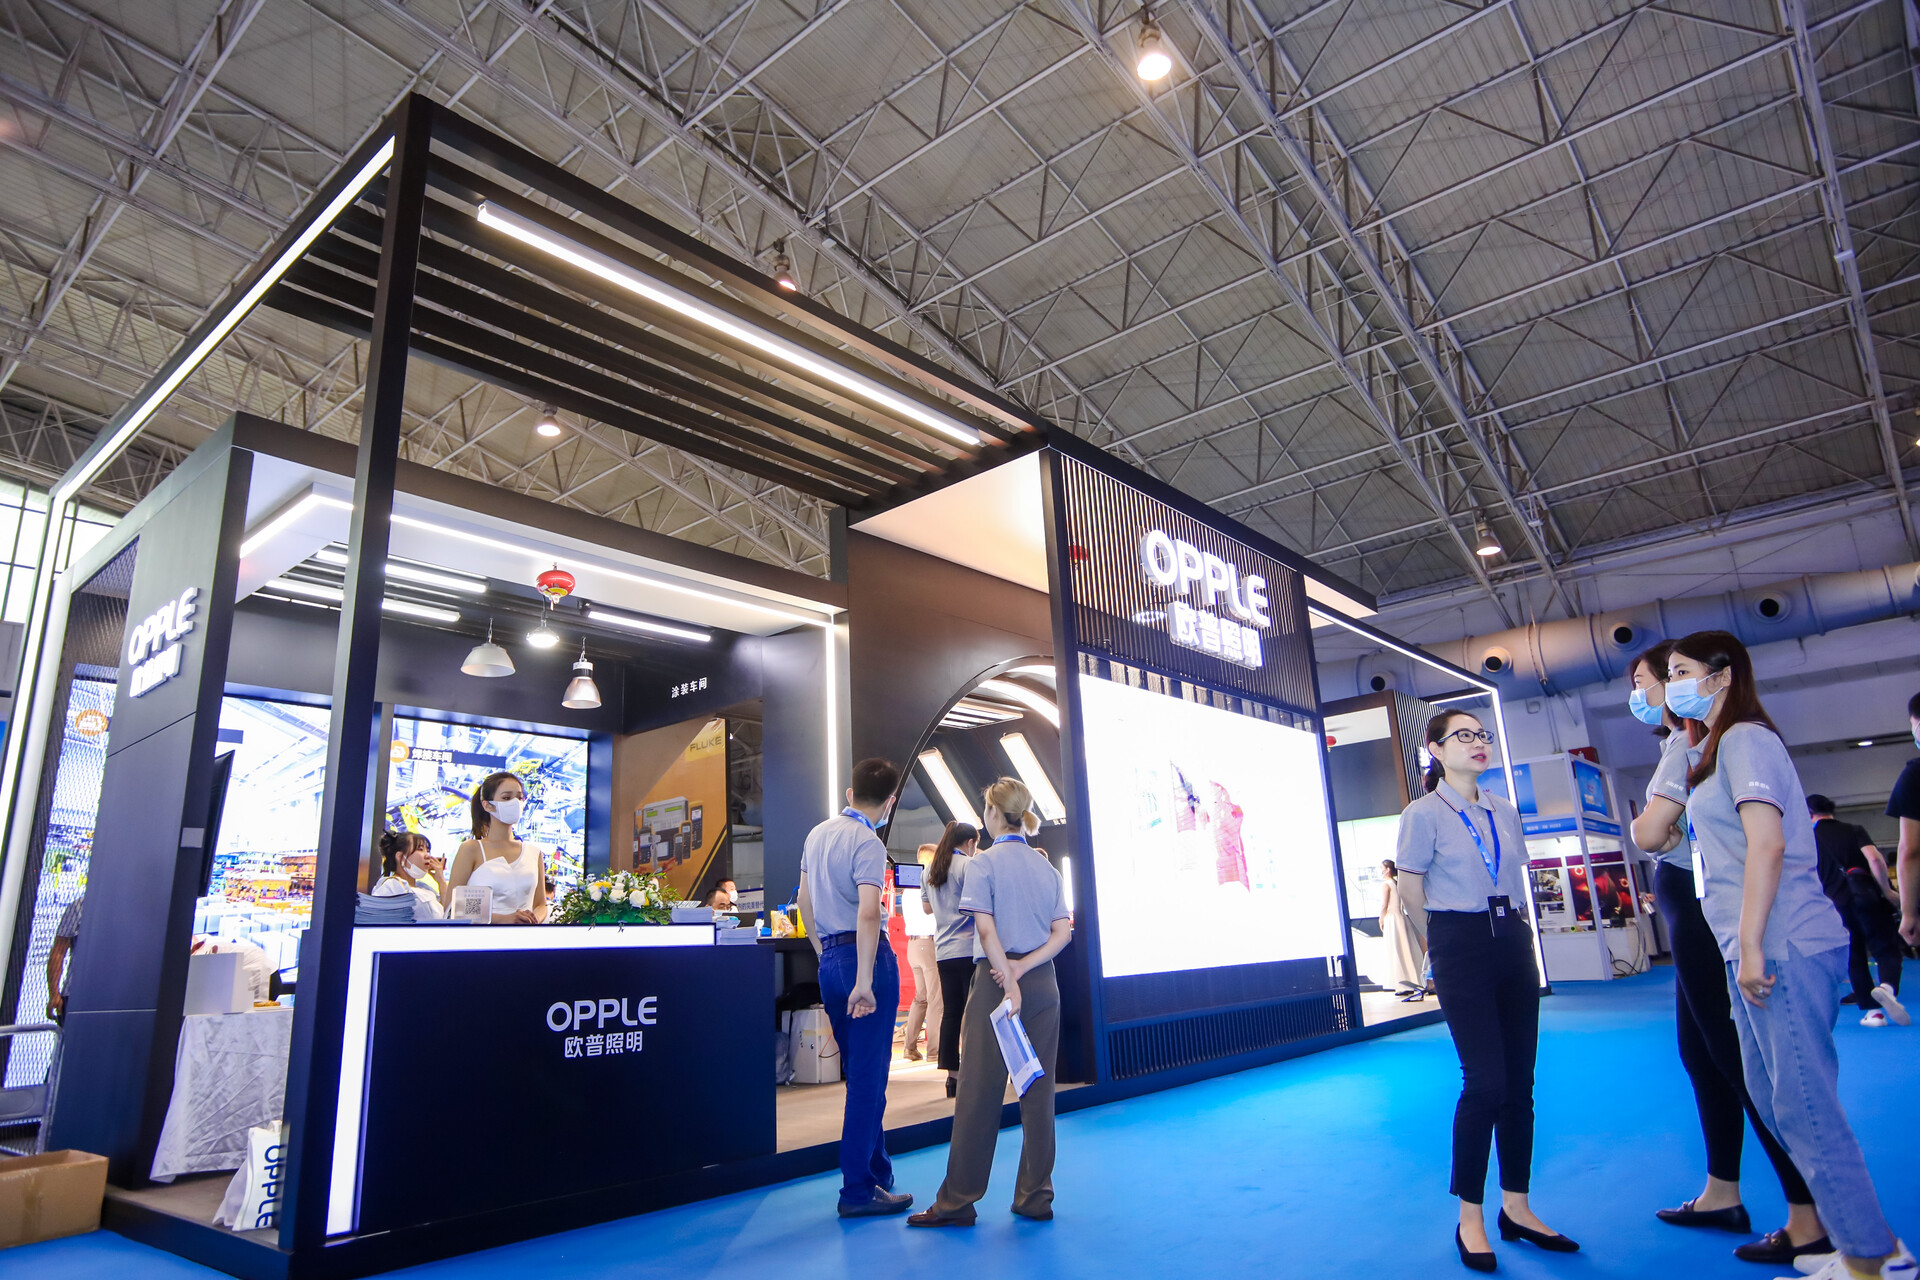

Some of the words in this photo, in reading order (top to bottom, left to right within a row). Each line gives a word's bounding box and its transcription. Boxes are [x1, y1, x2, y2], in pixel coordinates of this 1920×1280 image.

[1142, 529, 1271, 628] OPPLE
[128, 587, 198, 665] OPPLE
[1170, 600, 1263, 667] 欧普照明
[671, 676, 708, 698] 涂装车间
[689, 736, 722, 752] FLUKE
[546, 995, 658, 1032] OPPLE
[564, 1030, 643, 1058] 欧普照明
